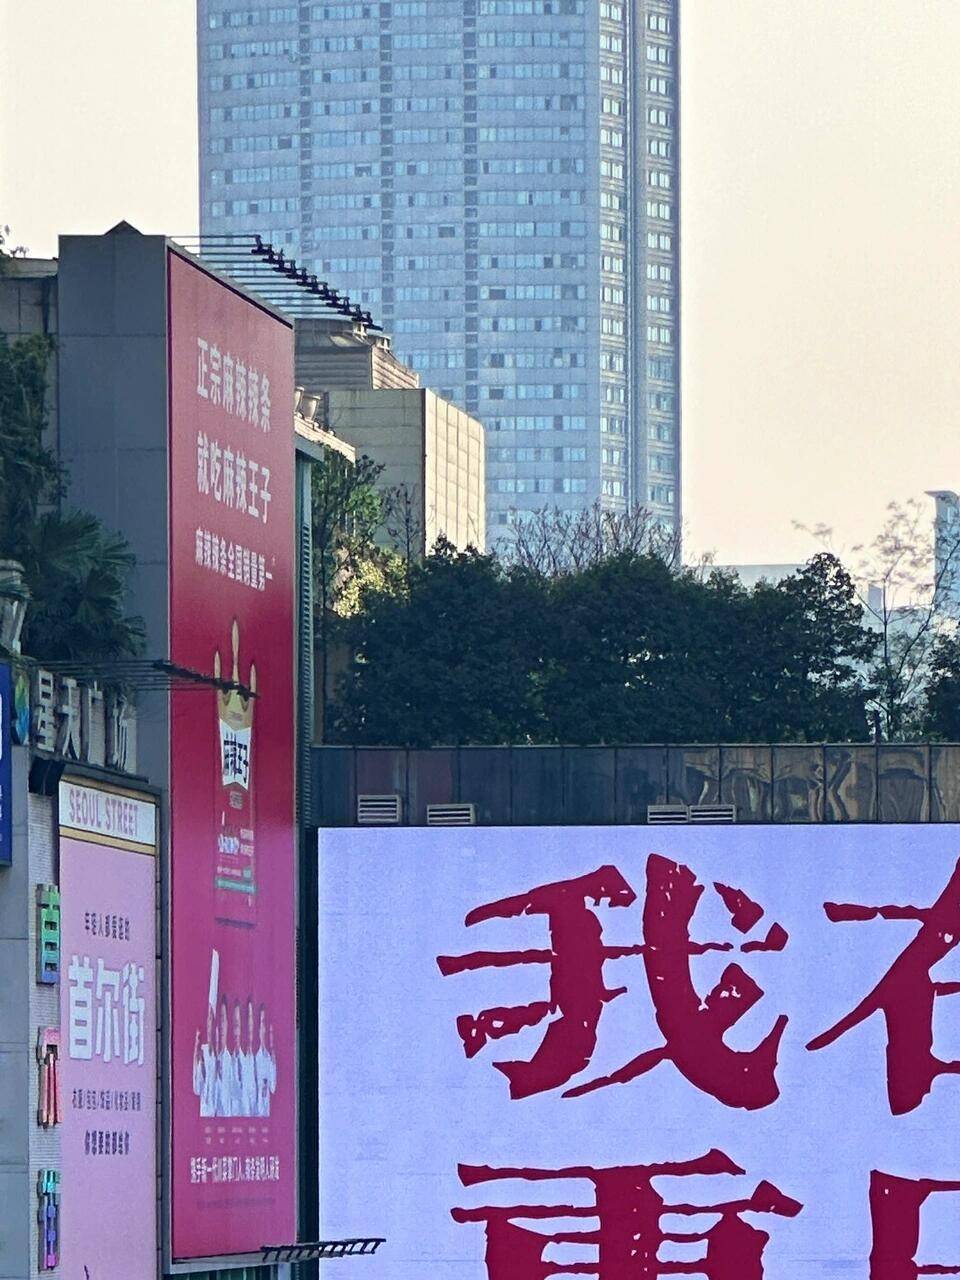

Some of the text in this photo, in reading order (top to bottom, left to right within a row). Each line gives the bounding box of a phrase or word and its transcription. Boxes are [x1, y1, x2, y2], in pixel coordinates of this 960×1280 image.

[197, 430, 271, 523] 就吃麻辣王子
[69, 788, 139, 836] SEOUL STREET
[69, 955, 145, 1066] 首尔街
